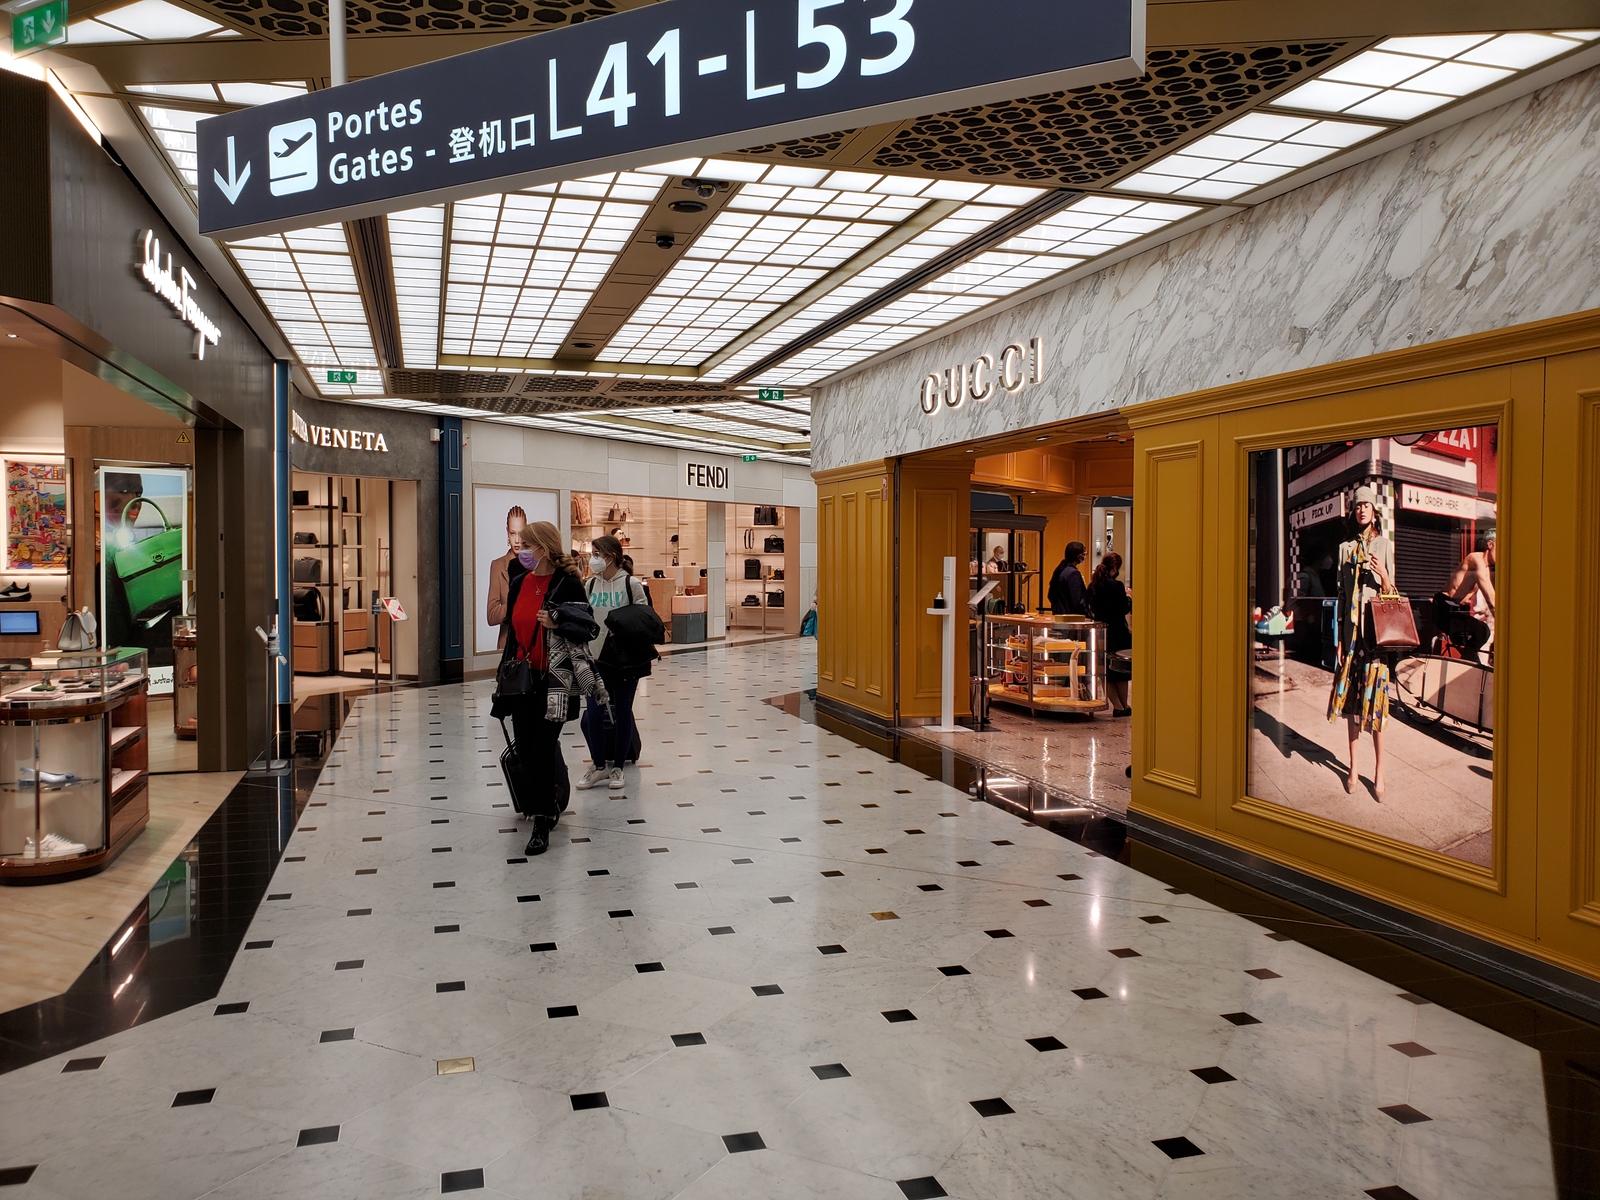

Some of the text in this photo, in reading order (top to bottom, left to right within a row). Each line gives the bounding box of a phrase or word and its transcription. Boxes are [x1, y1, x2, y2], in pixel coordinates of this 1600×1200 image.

[328, 98, 423, 143] Portes
[329, 145, 413, 185] Gates
[448, 113, 536, 164] 登机口
[920, 337, 1044, 416] GUCCI
[309, 424, 389, 452] VENETA
[686, 462, 729, 490] FENDI
[1311, 503, 1334, 520] PICK UP
[1424, 495, 1459, 510] ORDER HERE
